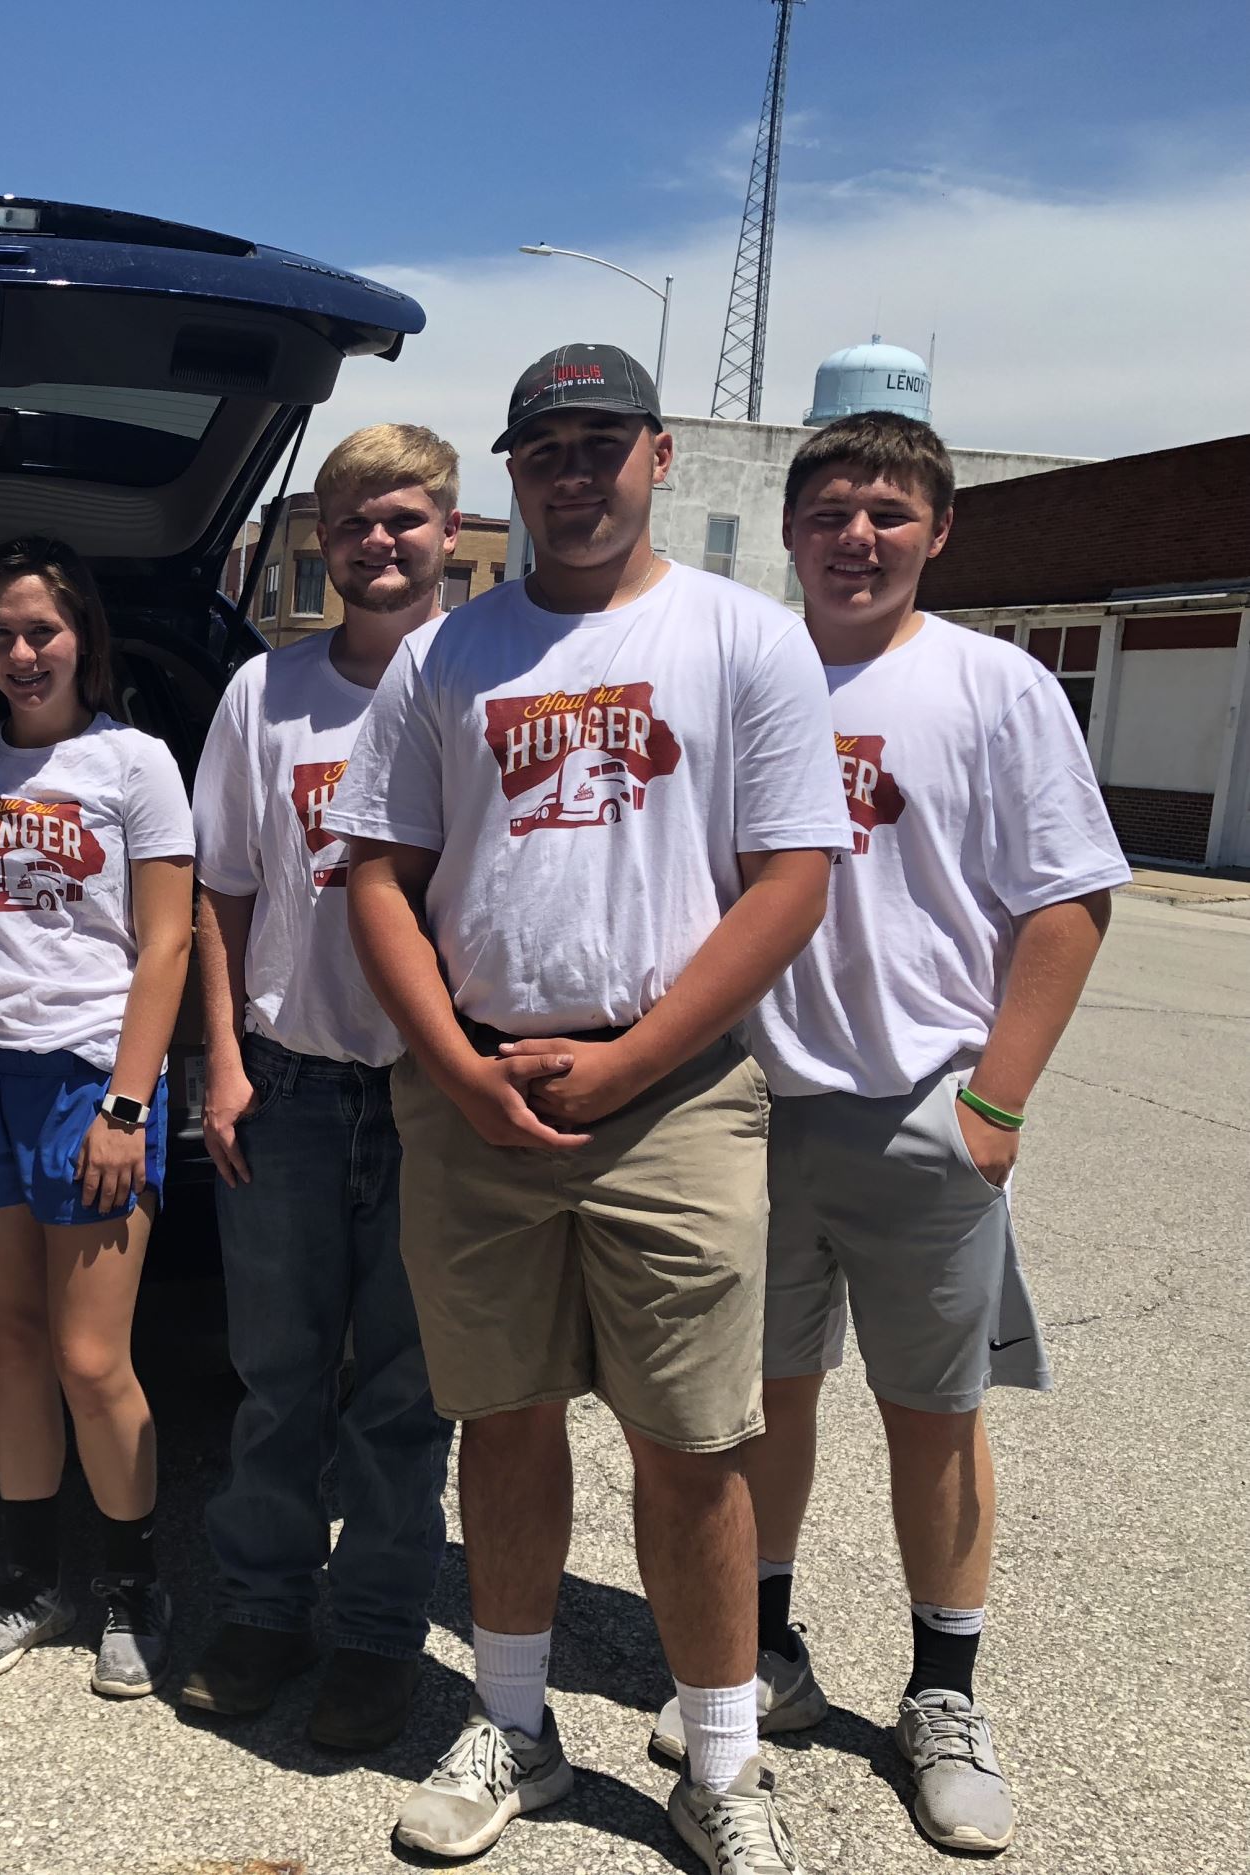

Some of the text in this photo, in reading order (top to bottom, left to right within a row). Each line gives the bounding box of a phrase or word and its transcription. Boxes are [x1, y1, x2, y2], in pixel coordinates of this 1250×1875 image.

[886, 373, 925, 394] LENOX
[524, 691, 585, 718] Hau
[503, 706, 651, 776] HUNGER
